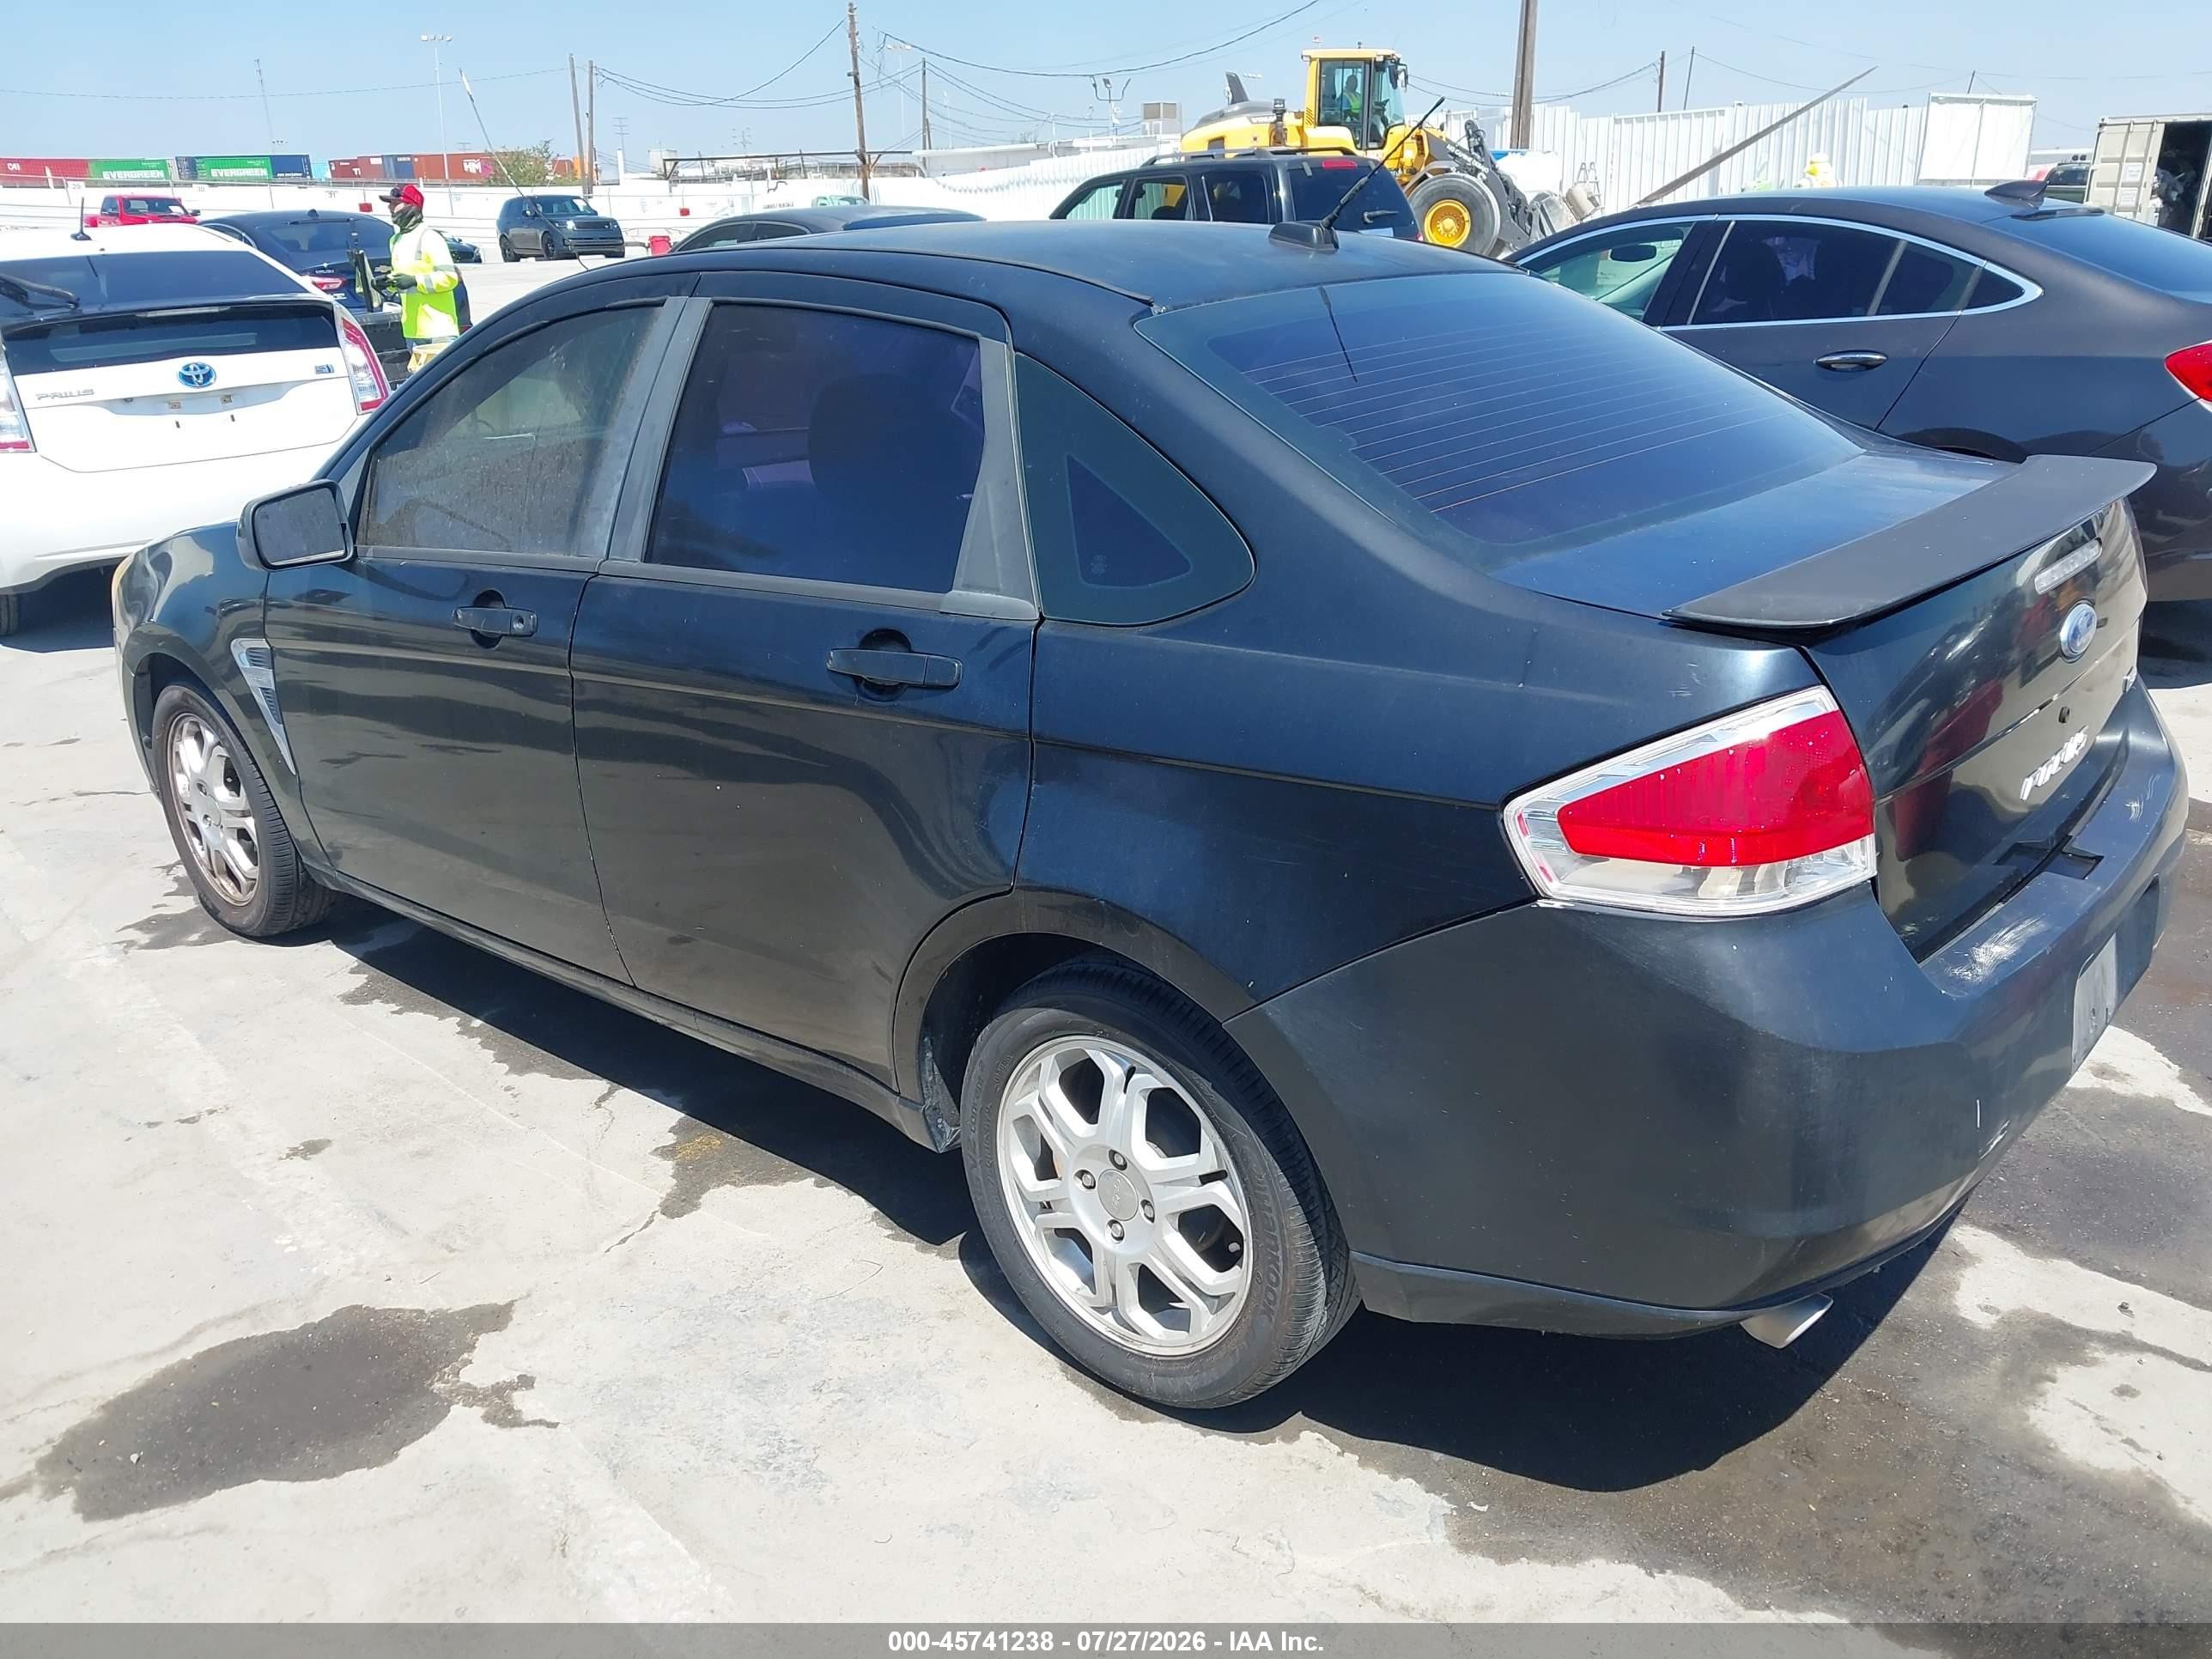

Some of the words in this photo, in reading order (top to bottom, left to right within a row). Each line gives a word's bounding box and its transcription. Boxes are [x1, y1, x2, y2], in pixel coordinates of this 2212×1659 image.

[102, 170, 166, 179] EVERGREEN
[210, 167, 268, 178] EVERGREEN
[35, 388, 95, 401] PRIUS
